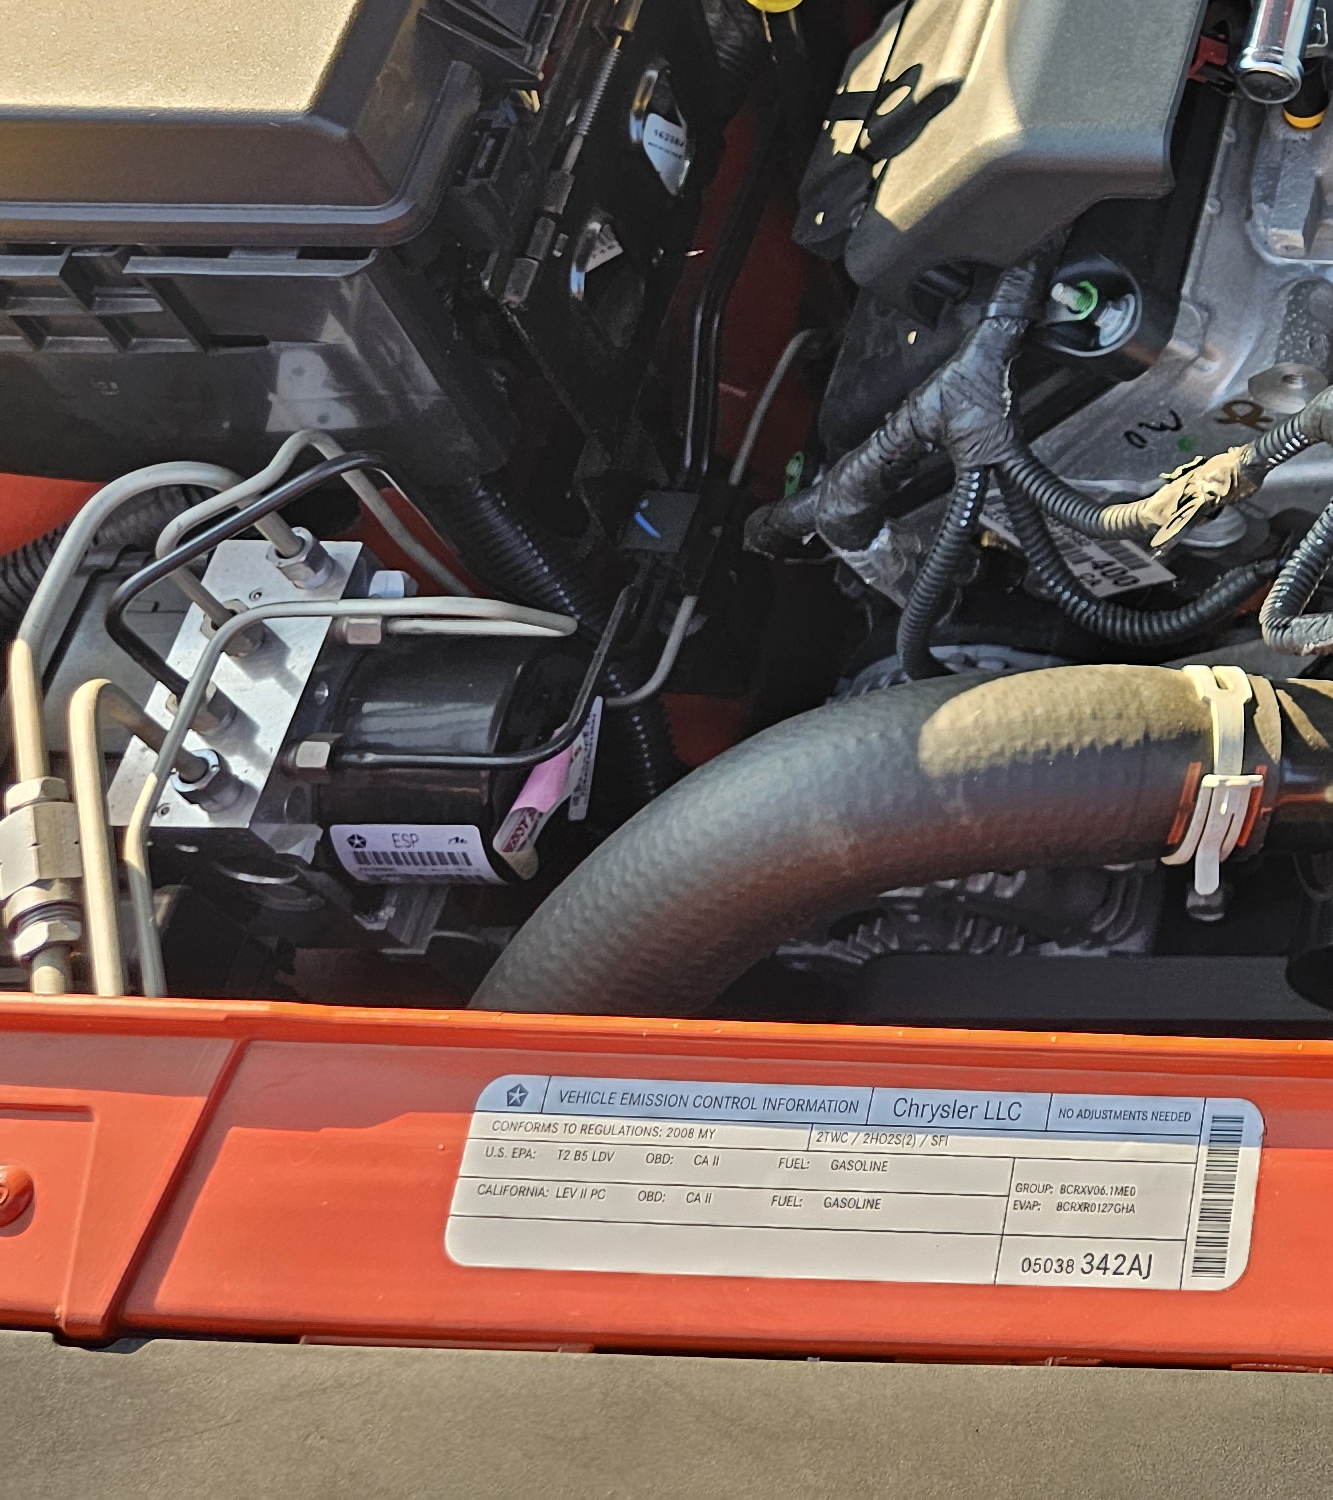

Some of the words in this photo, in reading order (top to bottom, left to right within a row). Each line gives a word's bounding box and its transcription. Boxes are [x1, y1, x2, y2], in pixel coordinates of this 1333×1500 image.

[1091, 561, 1140, 586] 400
[392, 833, 420, 849] ESP
[560, 1090, 617, 1105] VEHICLE
[620, 1092, 689, 1108] EMISSION
[692, 1095, 758, 1110] CONTROL
[762, 1097, 859, 1113] INFORMATION
[893, 1097, 978, 1123] Chrysler
[984, 1100, 1022, 1121] LLC
[1058, 1108, 1074, 1118] NO
[1076, 1109, 1148, 1121] ADJUSTMENTS
[1150, 1111, 1191, 1122] NEEDED
[492, 1120, 559, 1133] CONFORMS
[563, 1123, 577, 1134] TO
[579, 1123, 662, 1137] REGULATIONS:
[666, 1127, 694, 1138] 2008
[697, 1128, 716, 1139] MY
[816, 1132, 848, 1144] 2TWC
[931, 1135, 948, 1147] SFI
[486, 1147, 507, 1158] U.S.
[511, 1147, 536, 1159] EPA:
[558, 1149, 571, 1160] T2
[573, 1150, 588, 1161] B5
[591, 1150, 615, 1162] LDV
[645, 1152, 674, 1164] OBD:
[693, 1154, 708, 1166] CA
[712, 1155, 719, 1166] II
[778, 1157, 810, 1169] FUEL:
[830, 1159, 889, 1172] GASOLINE
[477, 1184, 549, 1197] CALIFORNIA:
[555, 1187, 578, 1198] LEV
[579, 1187, 587, 1199] II
[589, 1188, 606, 1199] PC
[637, 1190, 666, 1202] OBD:
[686, 1191, 701, 1203] CA
[704, 1192, 712, 1204] II
[770, 1195, 803, 1207] FUEL:
[823, 1196, 881, 1209] GASOLINE
[1021, 1258, 1074, 1274] 05038
[1081, 1253, 1153, 1280] 342AJ
